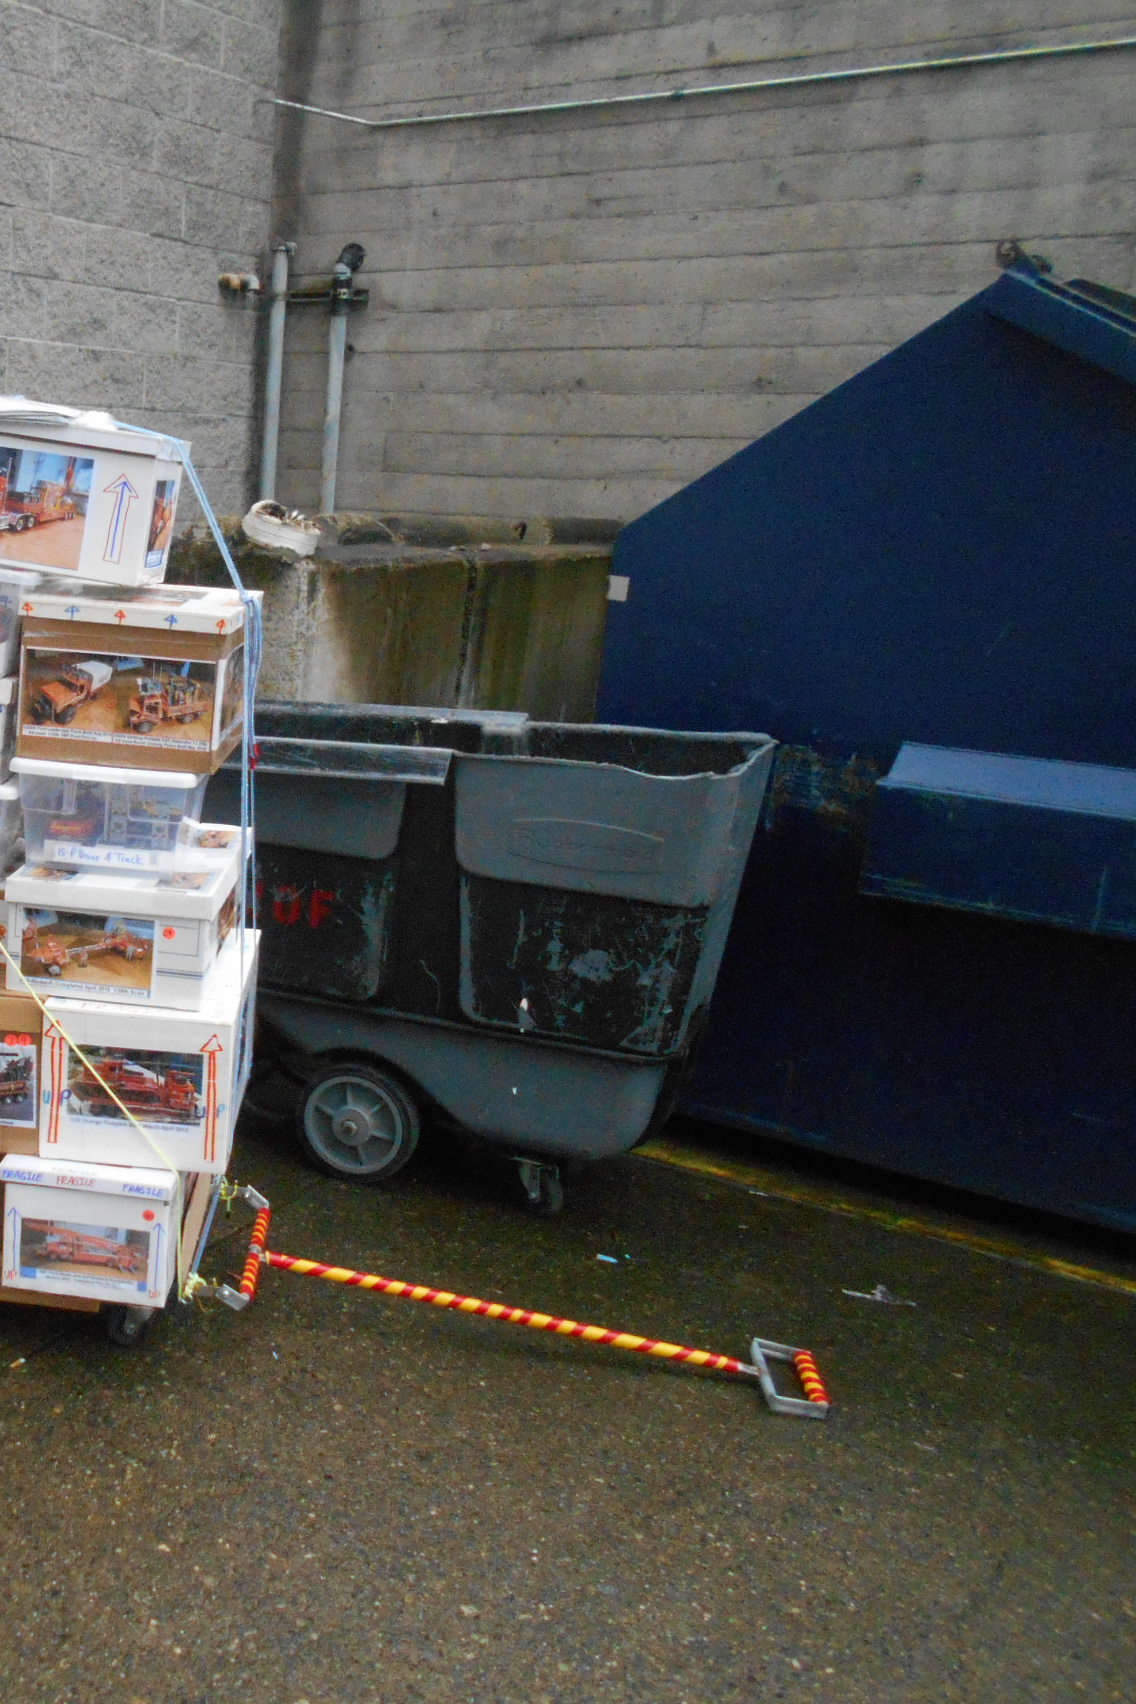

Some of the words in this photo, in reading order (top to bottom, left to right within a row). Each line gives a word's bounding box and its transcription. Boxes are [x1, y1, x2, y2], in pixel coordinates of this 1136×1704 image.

[2, 1169, 44, 1182] FRAGILE
[56, 1175, 97, 1188] FRAGILE
[122, 1183, 163, 1198] FRAGILE
